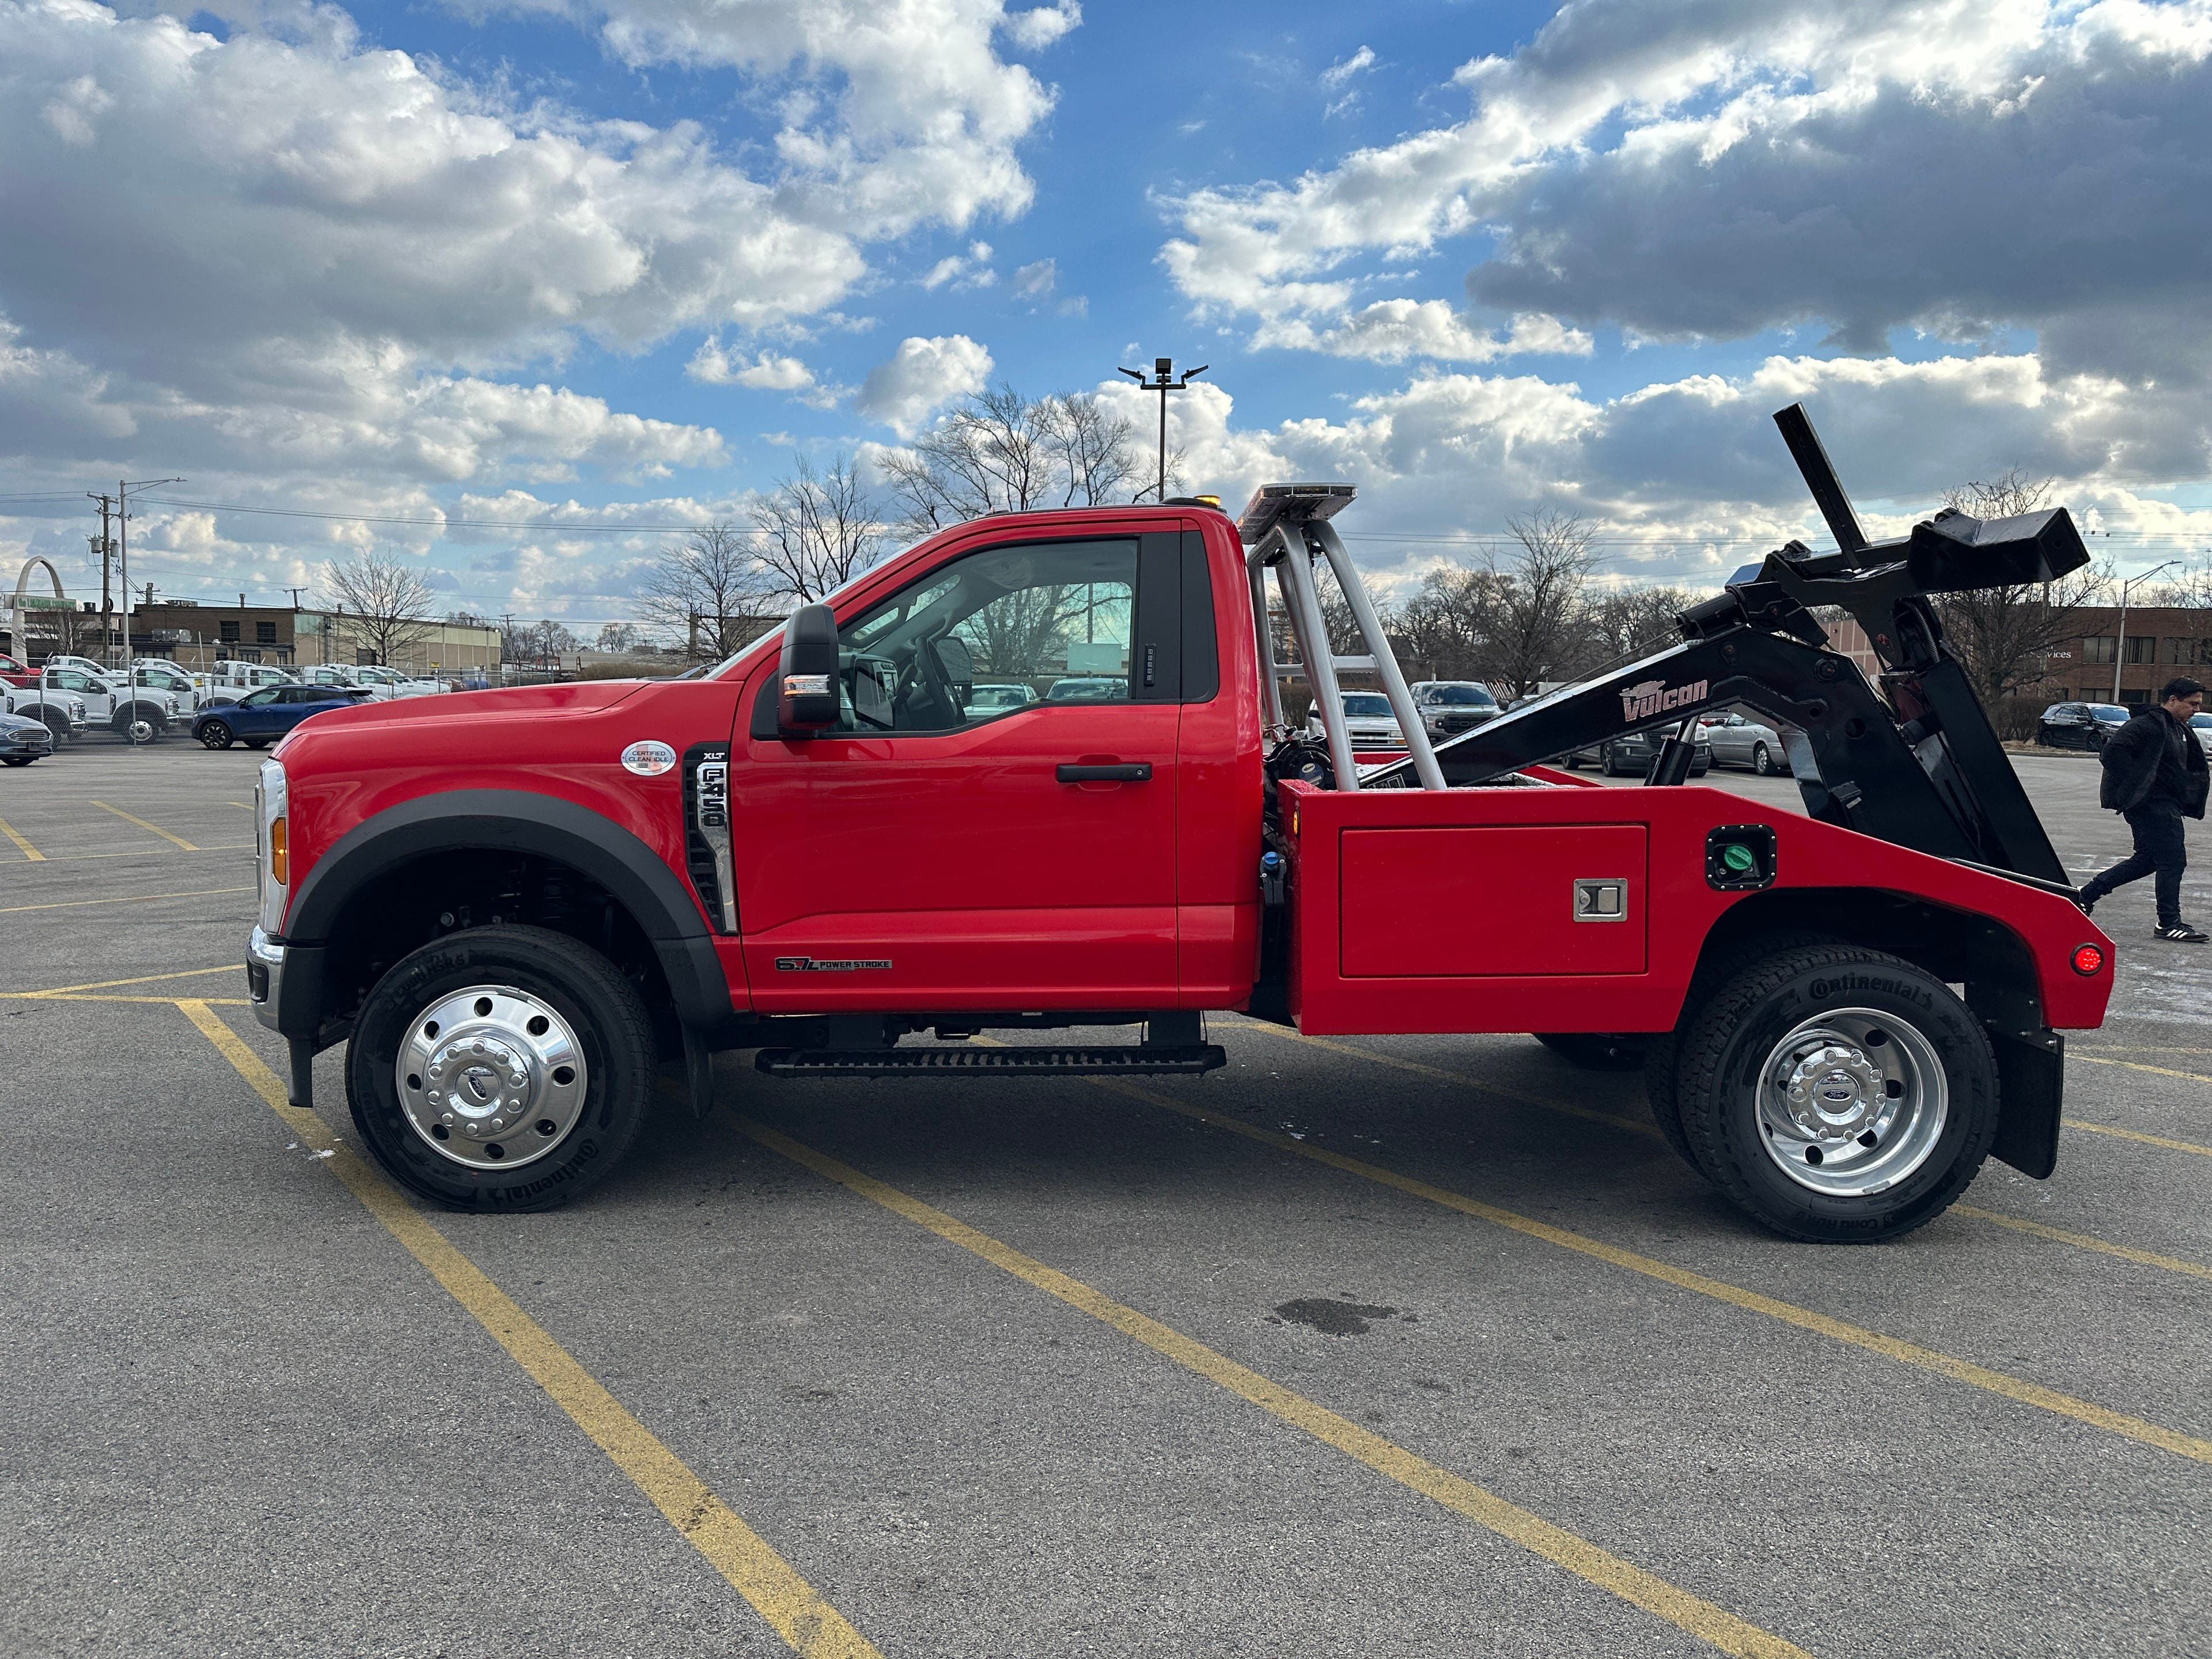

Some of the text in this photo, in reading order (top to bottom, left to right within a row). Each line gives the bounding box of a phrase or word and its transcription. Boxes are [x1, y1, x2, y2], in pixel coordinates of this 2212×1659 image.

[1623, 680, 1708, 722] Vulcan
[1809, 972, 1922, 1002] Continental
[504, 1138, 599, 1203] Continental
